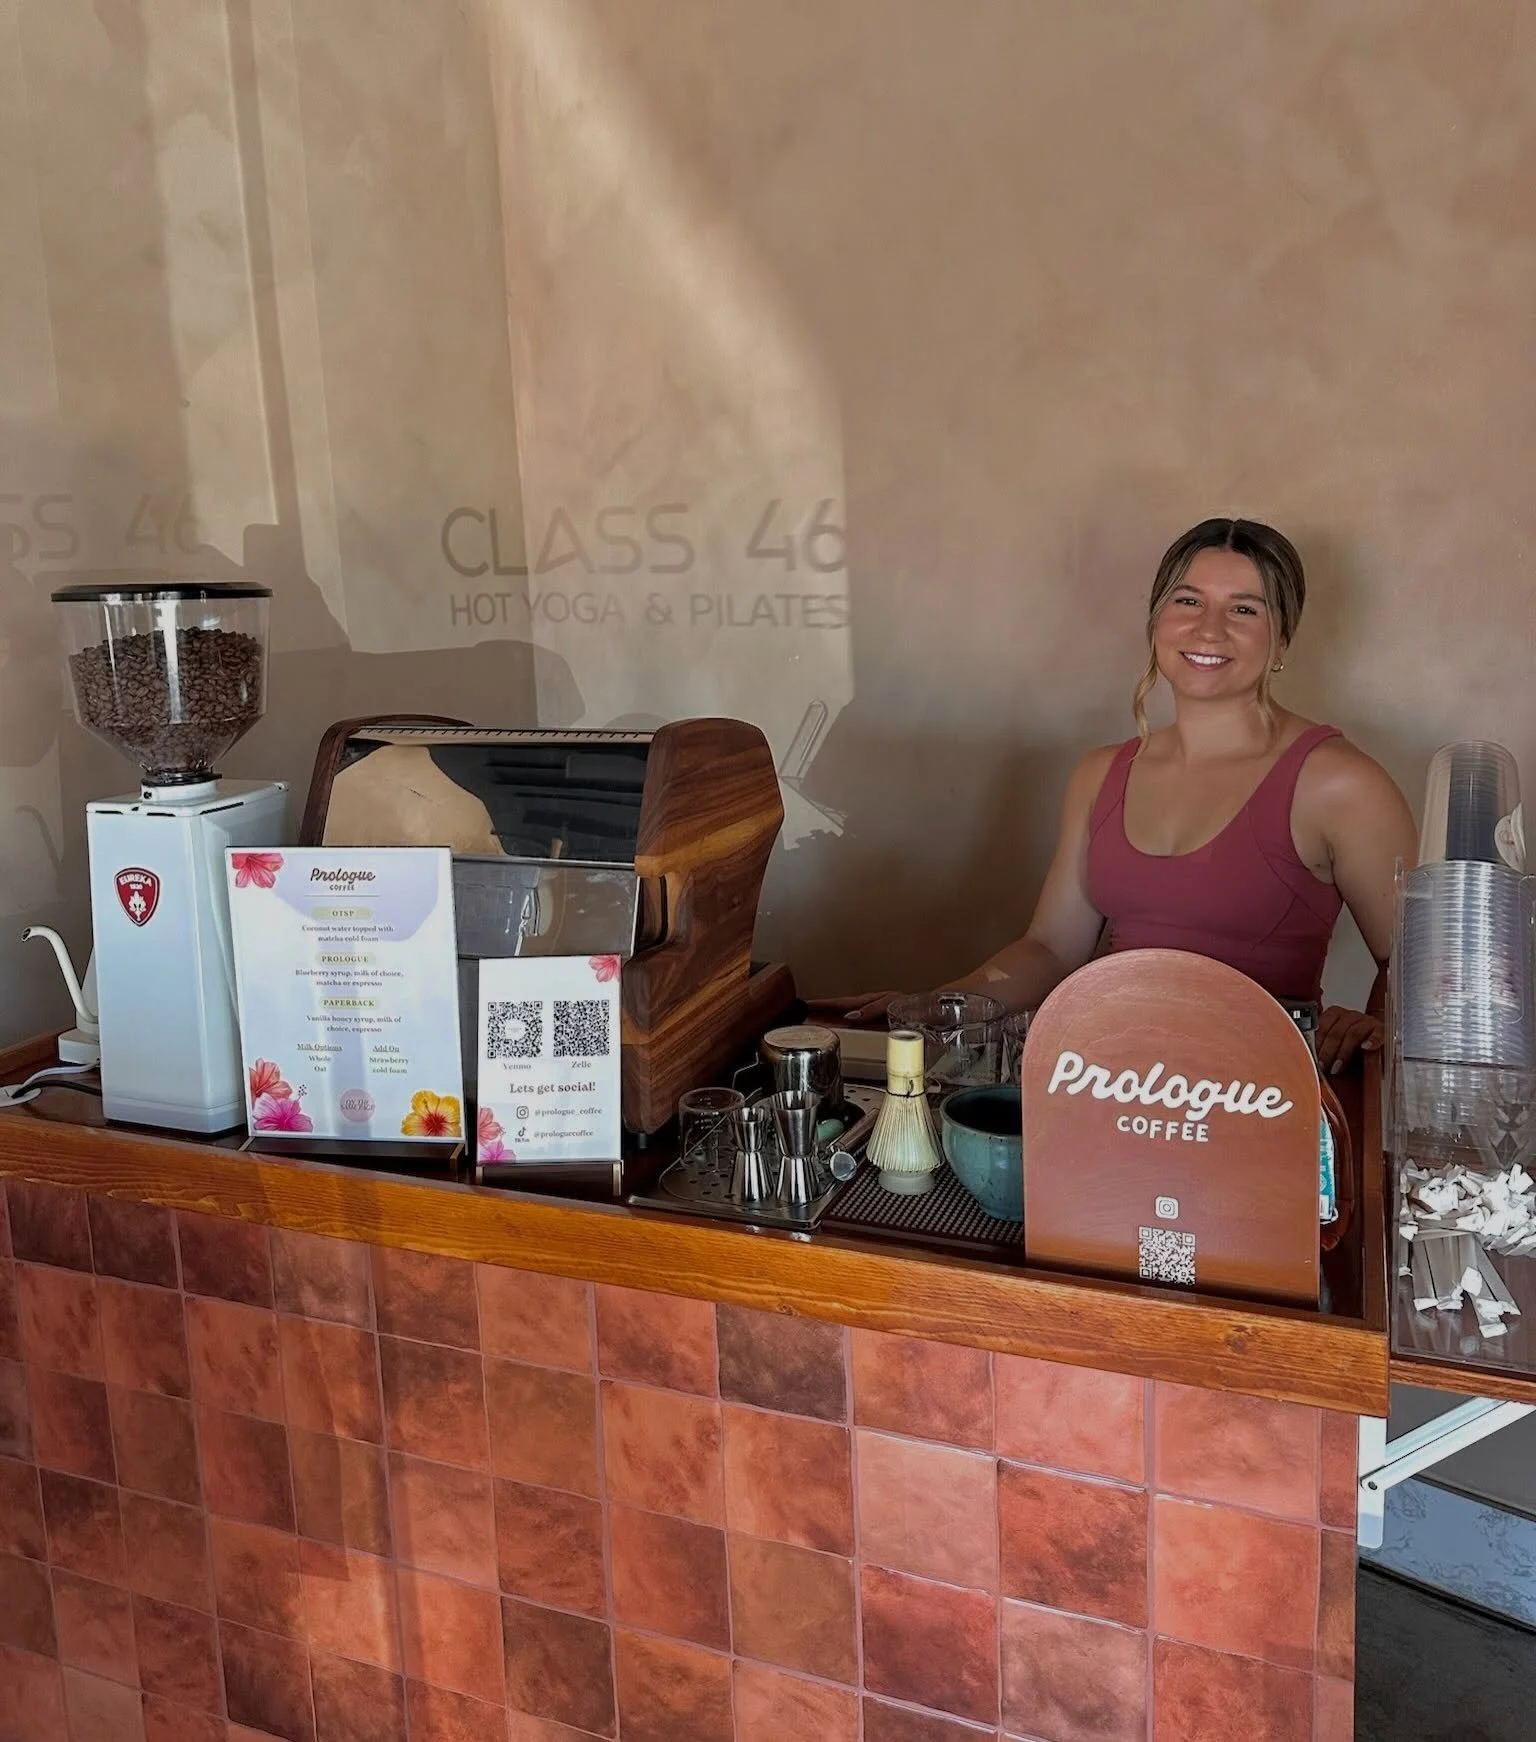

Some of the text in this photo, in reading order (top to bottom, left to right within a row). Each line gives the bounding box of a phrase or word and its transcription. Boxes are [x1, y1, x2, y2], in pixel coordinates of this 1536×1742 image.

[441, 499, 848, 578] CLASS 46
[450, 592, 850, 629] HOT YOGA & PILATES
[118, 873, 152, 887] EUREKA
[310, 868, 376, 884] Prologue
[352, 925, 377, 933] topped
[321, 955, 369, 963] PROLOGUE
[295, 969, 329, 977] Blueberry
[330, 970, 353, 978] syrup,
[323, 999, 375, 1007] PAPERBACK
[331, 1015, 352, 1023] honey
[297, 1043, 343, 1052] Milk Options
[388, 1045, 400, 1053] On
[369, 1056, 409, 1064] Strawberry
[571, 1060, 592, 1069] Zelle
[509, 1081, 596, 1095] Lets get social!
[1048, 1050, 1293, 1121] Prologue
[1117, 1115, 1209, 1142] COFFEE
